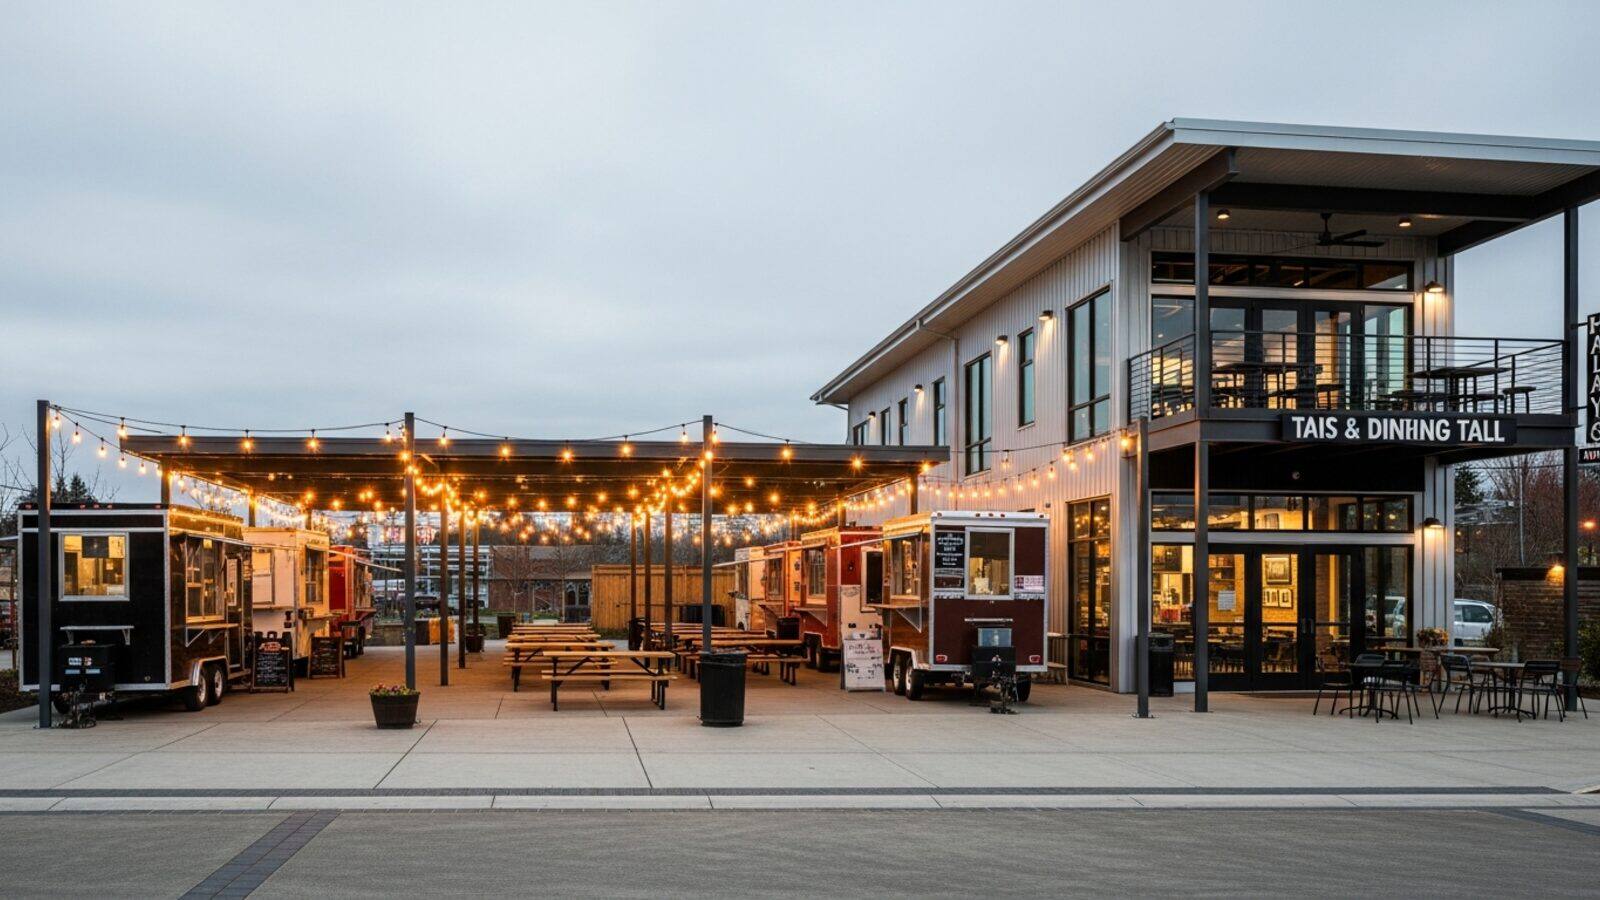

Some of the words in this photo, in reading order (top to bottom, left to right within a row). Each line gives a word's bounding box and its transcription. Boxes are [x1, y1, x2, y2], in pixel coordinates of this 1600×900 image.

[1291, 416, 1338, 439] TAIS
[1344, 417, 1360, 439] &
[1456, 419, 1505, 442] TALL
